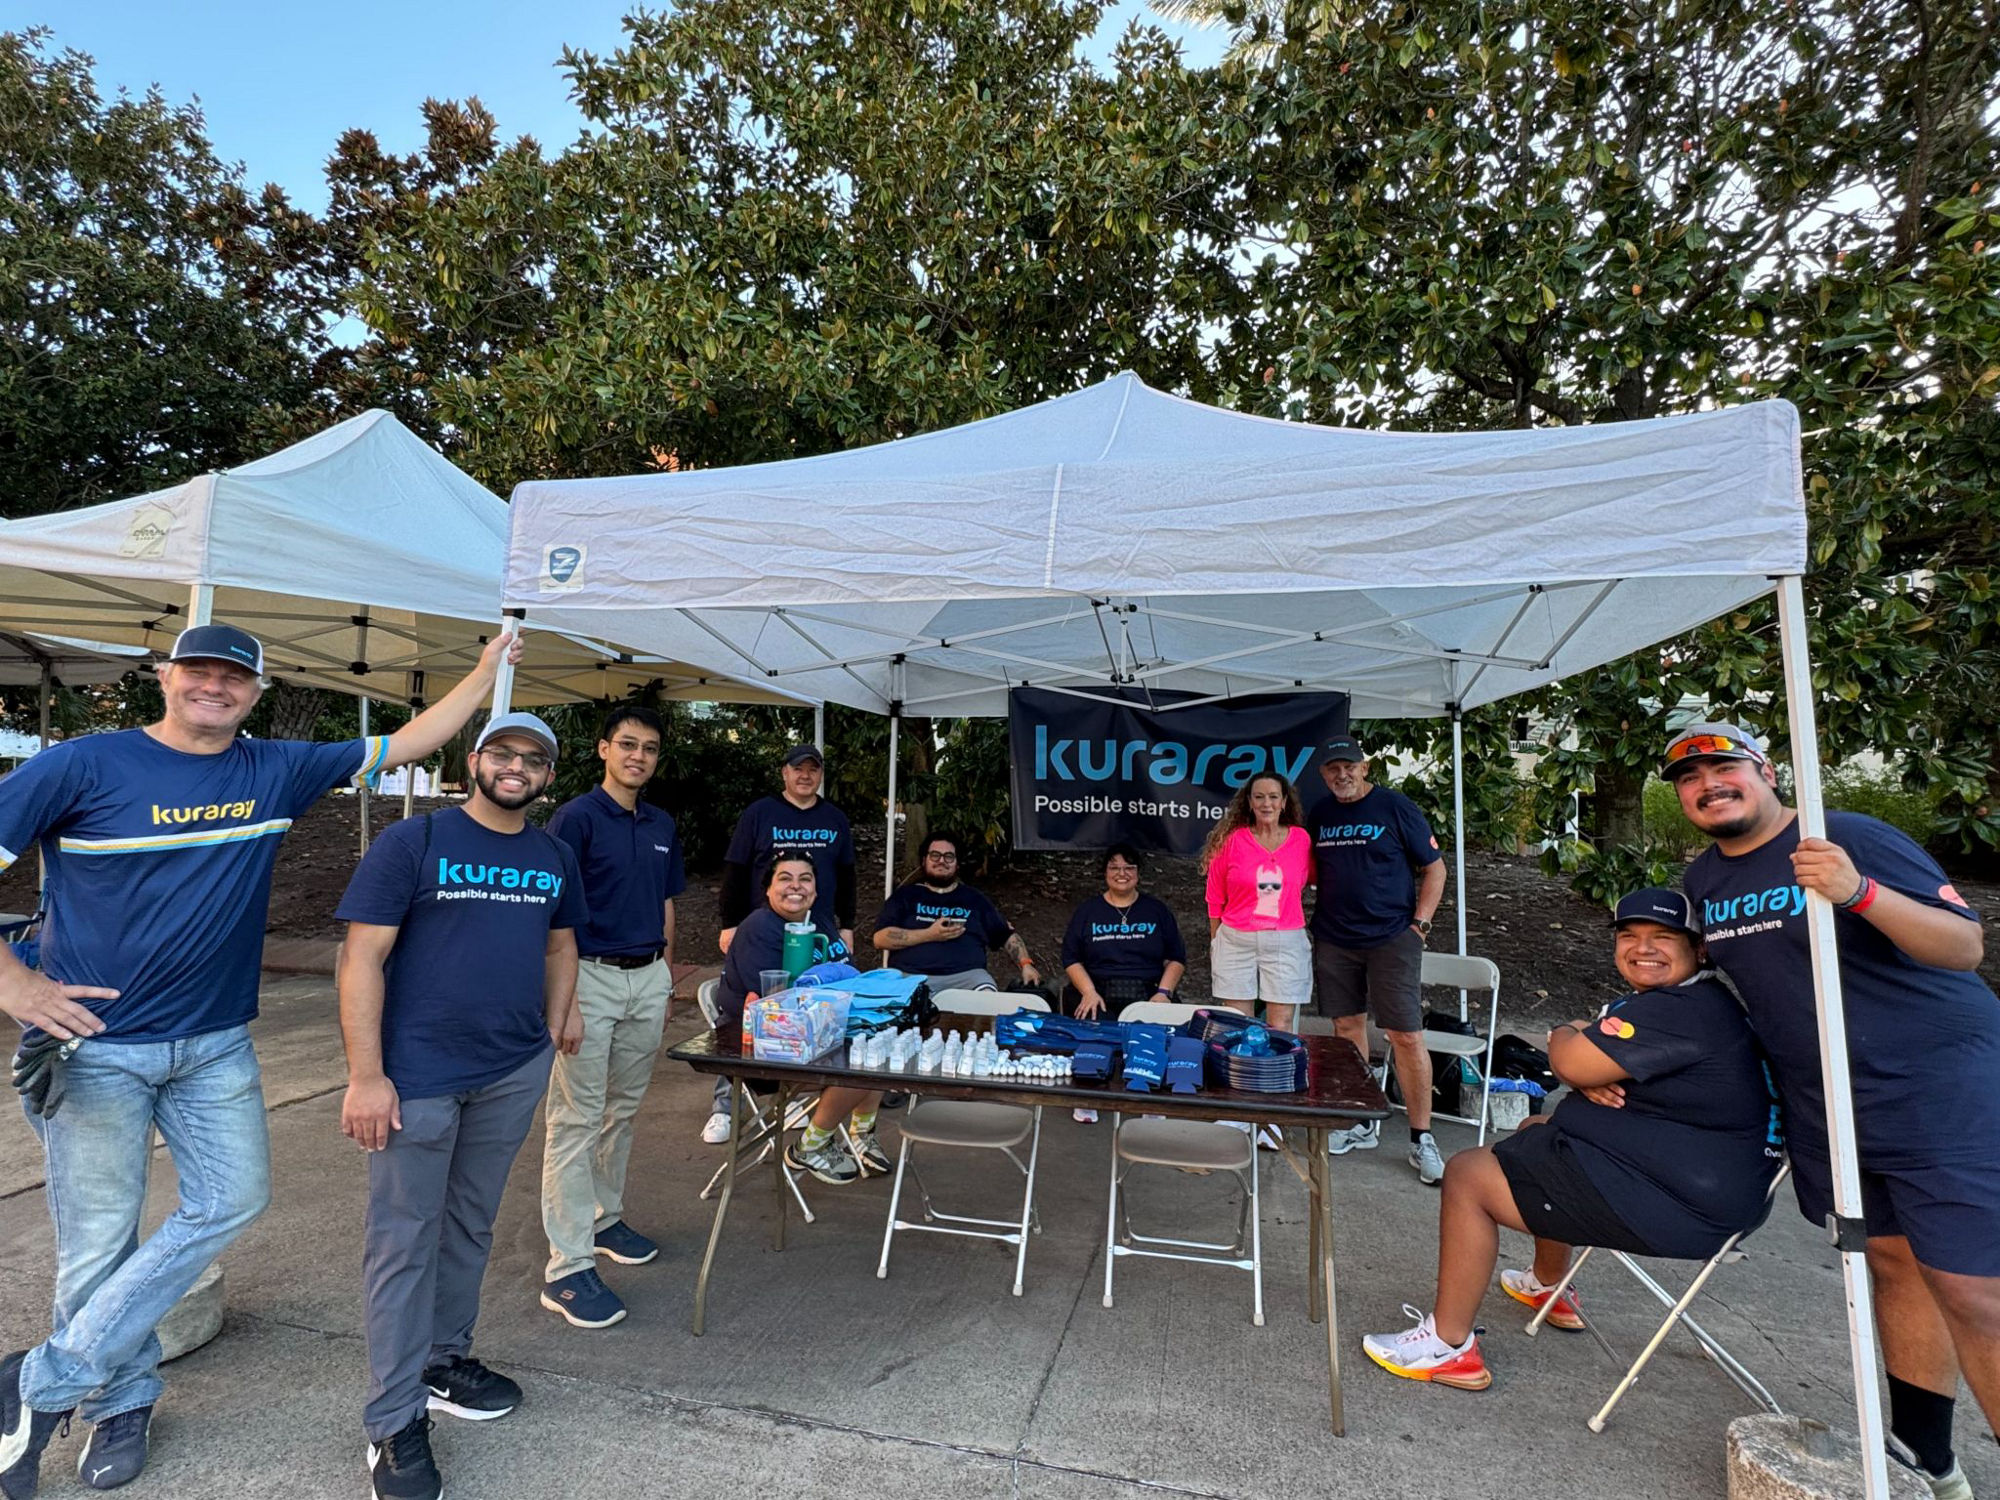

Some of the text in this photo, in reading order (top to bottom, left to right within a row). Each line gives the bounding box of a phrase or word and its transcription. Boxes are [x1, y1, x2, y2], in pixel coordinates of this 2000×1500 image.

[1035, 725, 1316, 788] kuraray
[152, 799, 256, 825] kuraray
[1035, 796, 1123, 813] Possible
[1128, 799, 1190, 818] starts
[773, 826, 838, 843] kuraray
[1320, 823, 1386, 841] kuraray
[439, 858, 562, 898] kuraray
[437, 889, 547, 904] Possible starts here
[1703, 885, 1807, 926] kuraray
[916, 903, 971, 918] kuraray
[1092, 922, 1157, 935] kuraray
[1737, 922, 1763, 936] starts
[1762, 919, 1783, 932] here
